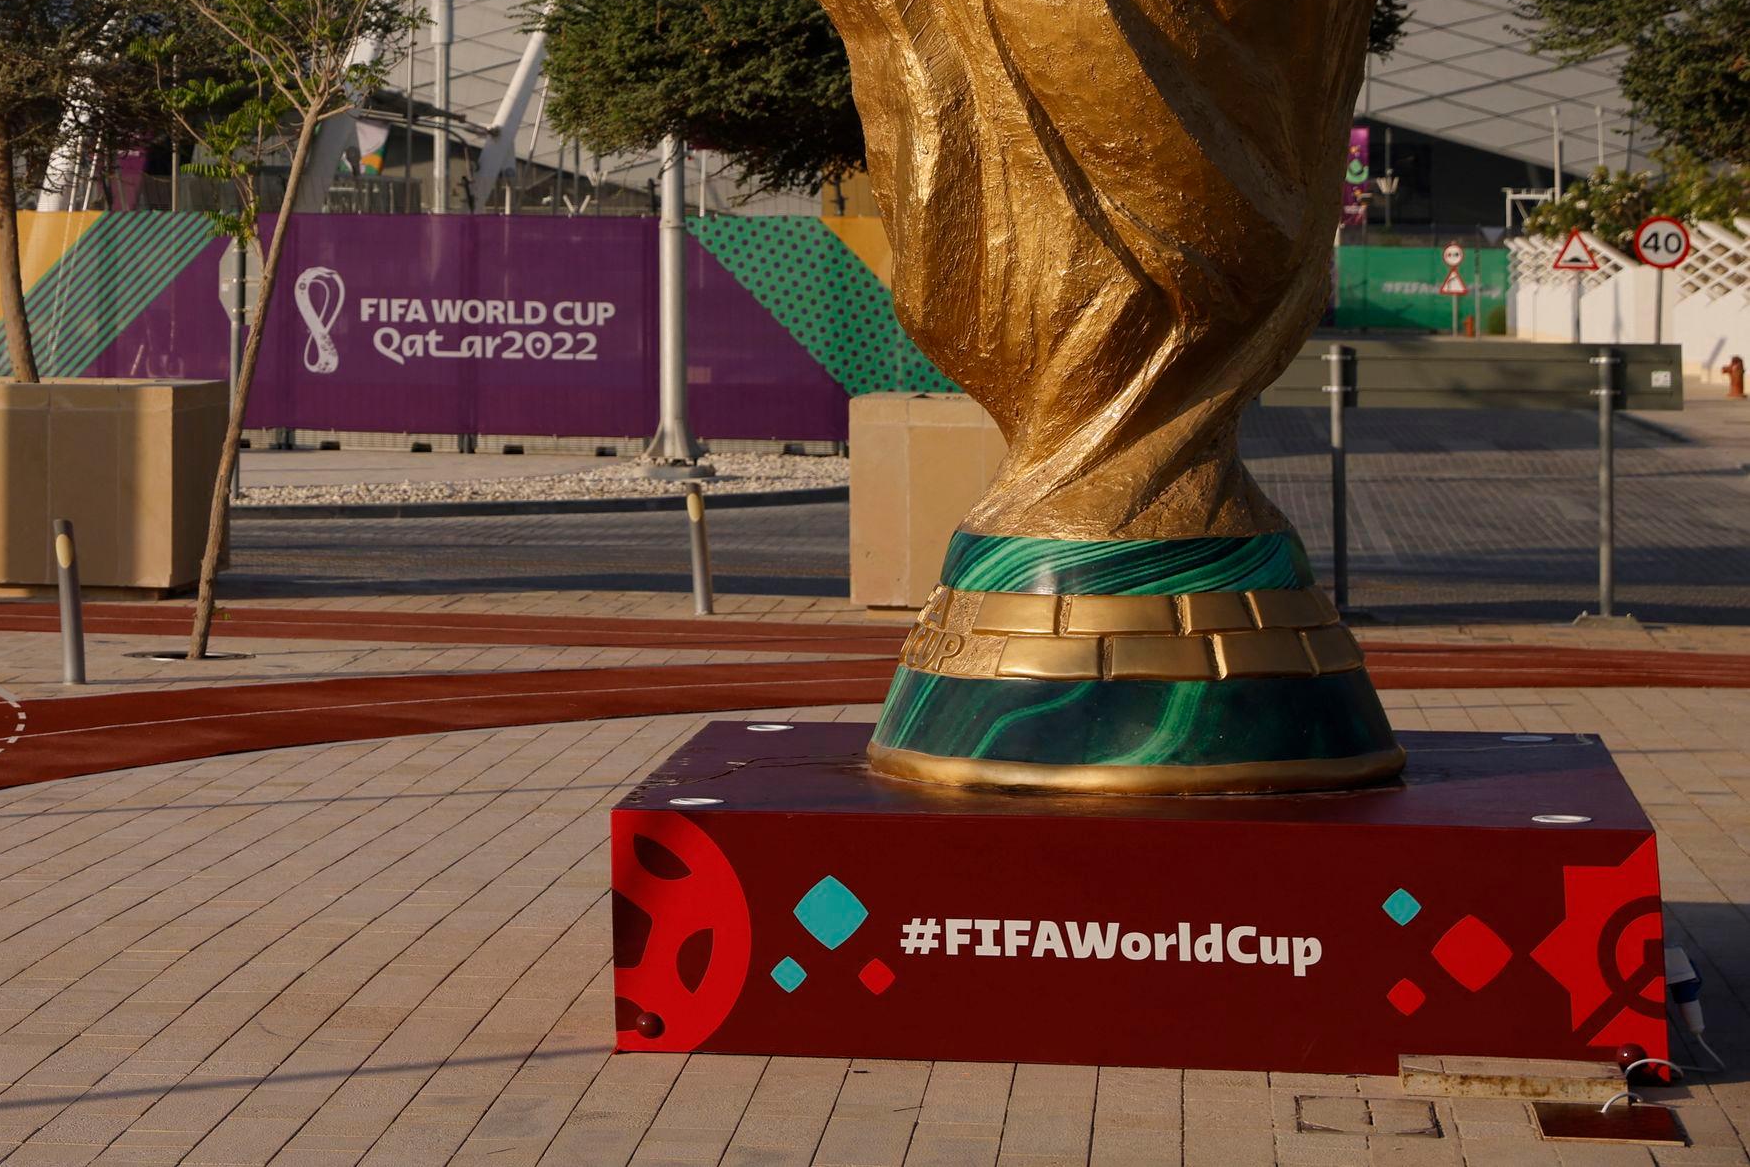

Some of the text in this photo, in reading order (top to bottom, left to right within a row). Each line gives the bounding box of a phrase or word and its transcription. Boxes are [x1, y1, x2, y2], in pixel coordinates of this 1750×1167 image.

[1642, 231, 1682, 254] 40
[360, 298, 616, 327] FIFA WORLD CUP
[899, 917, 1323, 977] #FIFAWorldCup
